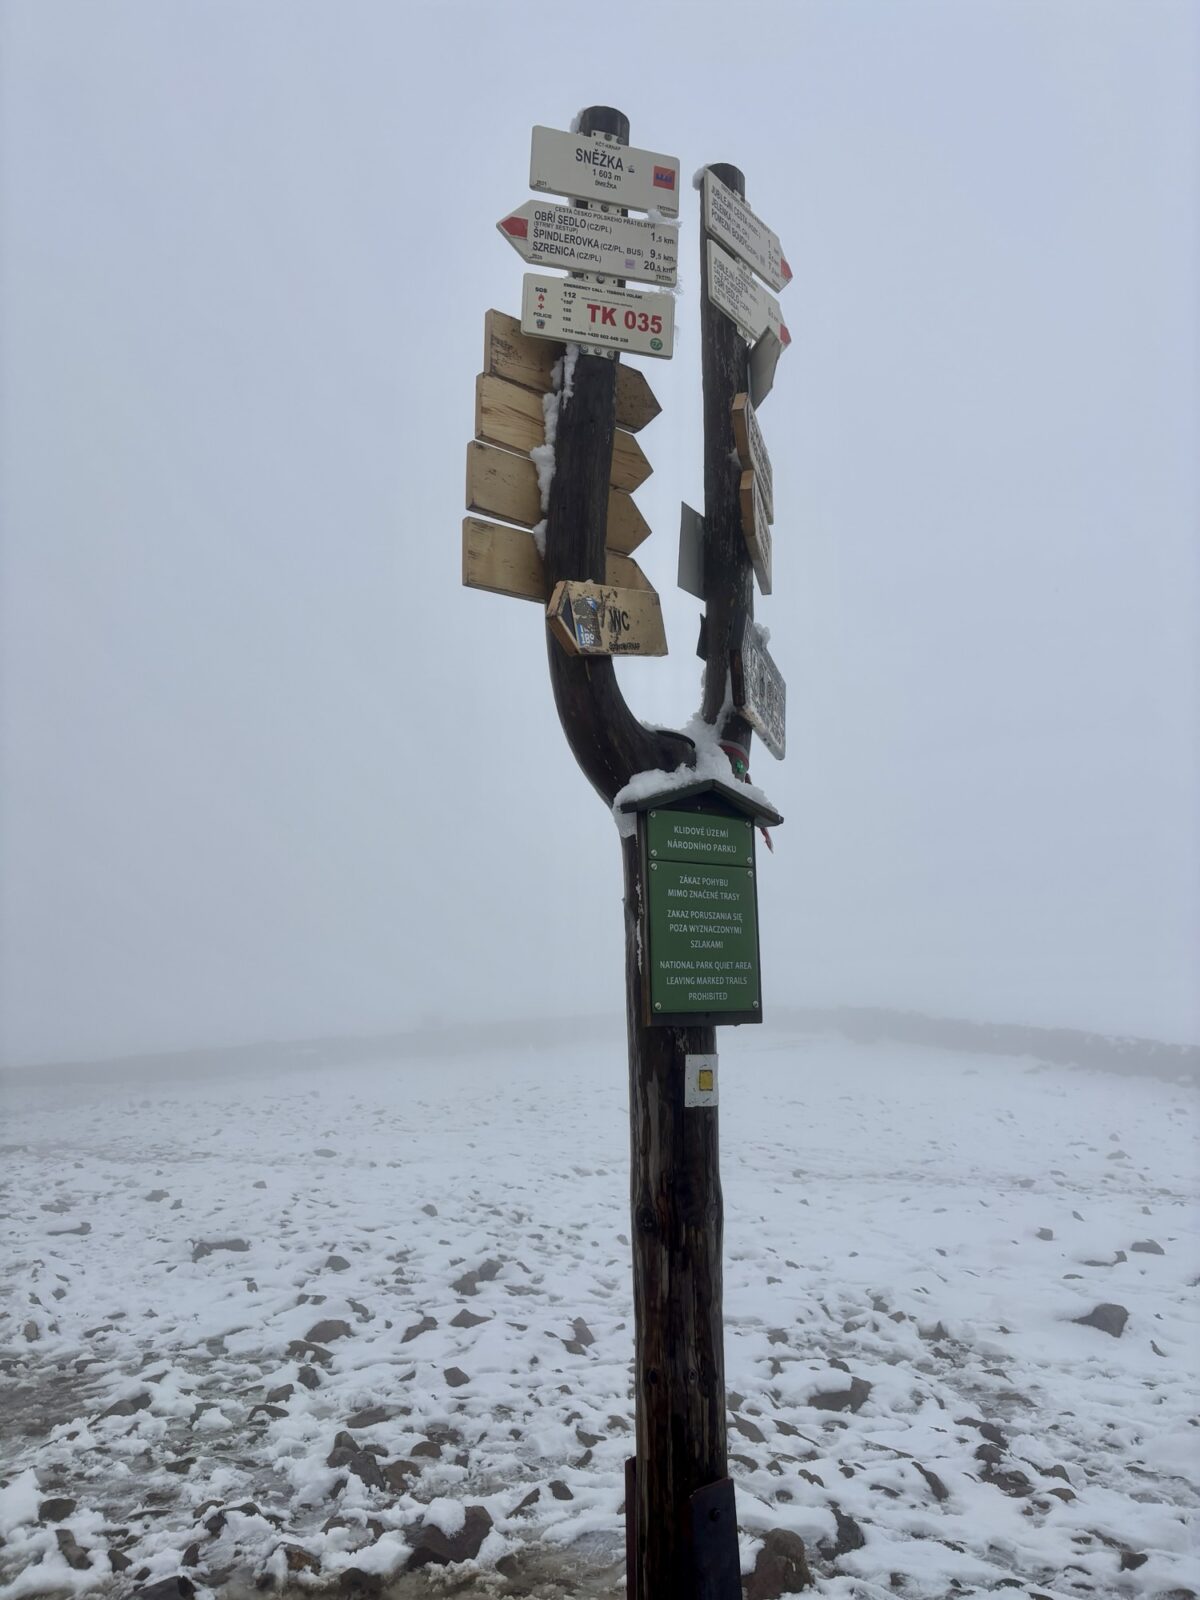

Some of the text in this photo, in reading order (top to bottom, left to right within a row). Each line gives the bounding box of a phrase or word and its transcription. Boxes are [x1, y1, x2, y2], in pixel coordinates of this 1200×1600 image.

[575, 148, 624, 171] SNĚŽKA
[598, 169, 611, 179] 603
[555, 206, 572, 214] CESTA
[534, 208, 555, 223] OBŘÍ
[558, 214, 586, 228] SEDLO
[586, 222, 612, 233] (CZ/PL)
[533, 227, 599, 248] ŠPINDLEROVKA
[626, 247, 643, 256] BUS)
[532, 241, 575, 257] SZRENICA
[576, 251, 601, 262] (CZ/PL)
[586, 303, 662, 334] TK 035
[609, 608, 630, 632] WC
[674, 826, 729, 838] KLIDOVÉ ÚZEMÍ
[667, 840, 736, 853] NÁRODNÍHO PARKU
[680, 875, 728, 886] ZÁKAZ POHYBU
[668, 889, 740, 901] MIMO ZNAČENÉ TRASY
[668, 910, 689, 918] ZAKAZ
[691, 911, 731, 920] PORUSZANIA
[670, 924, 742, 934] POZA WYZNACZONYMI
[690, 940, 723, 948] SZLAKAMI
[660, 961, 695, 969] NATIONAL
[696, 961, 713, 969] PARK
[715, 962, 734, 970] QUIET
[666, 977, 695, 985] LEAVING
[697, 977, 724, 985] MARKED
[688, 992, 727, 1000] PROHIBITED
